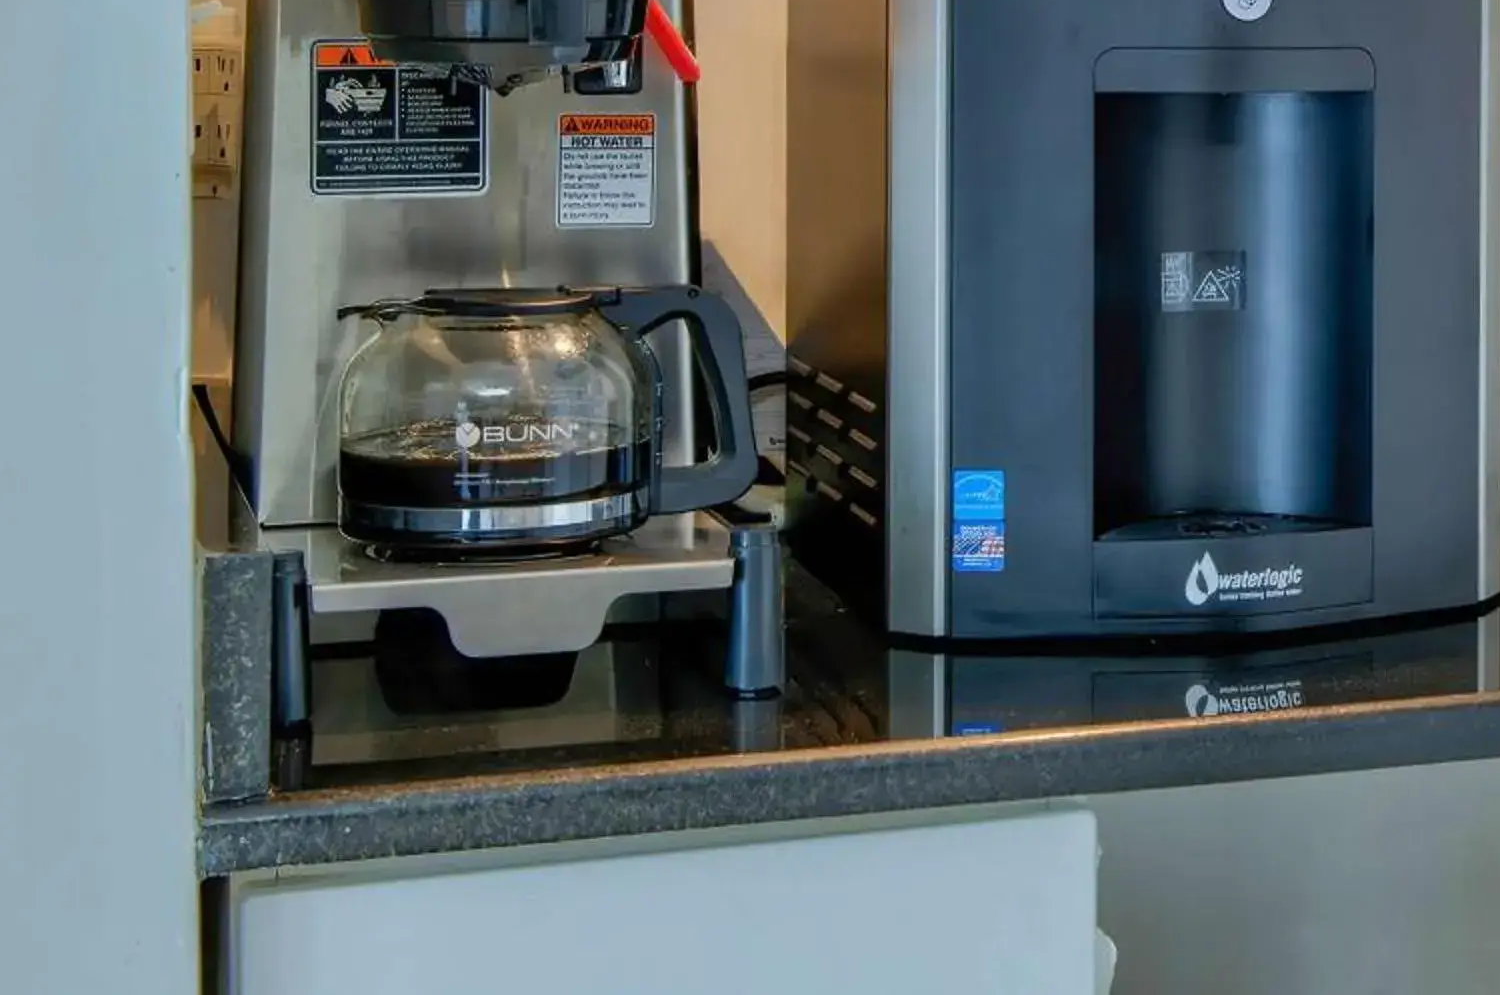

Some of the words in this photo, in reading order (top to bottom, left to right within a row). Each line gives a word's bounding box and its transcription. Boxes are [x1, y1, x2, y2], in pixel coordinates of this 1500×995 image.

[581, 118, 649, 132] WARNING
[571, 136, 597, 147] HOT
[600, 136, 644, 147] WATER
[483, 423, 574, 443] BUNN
[1218, 564, 1304, 589] waterlogic
